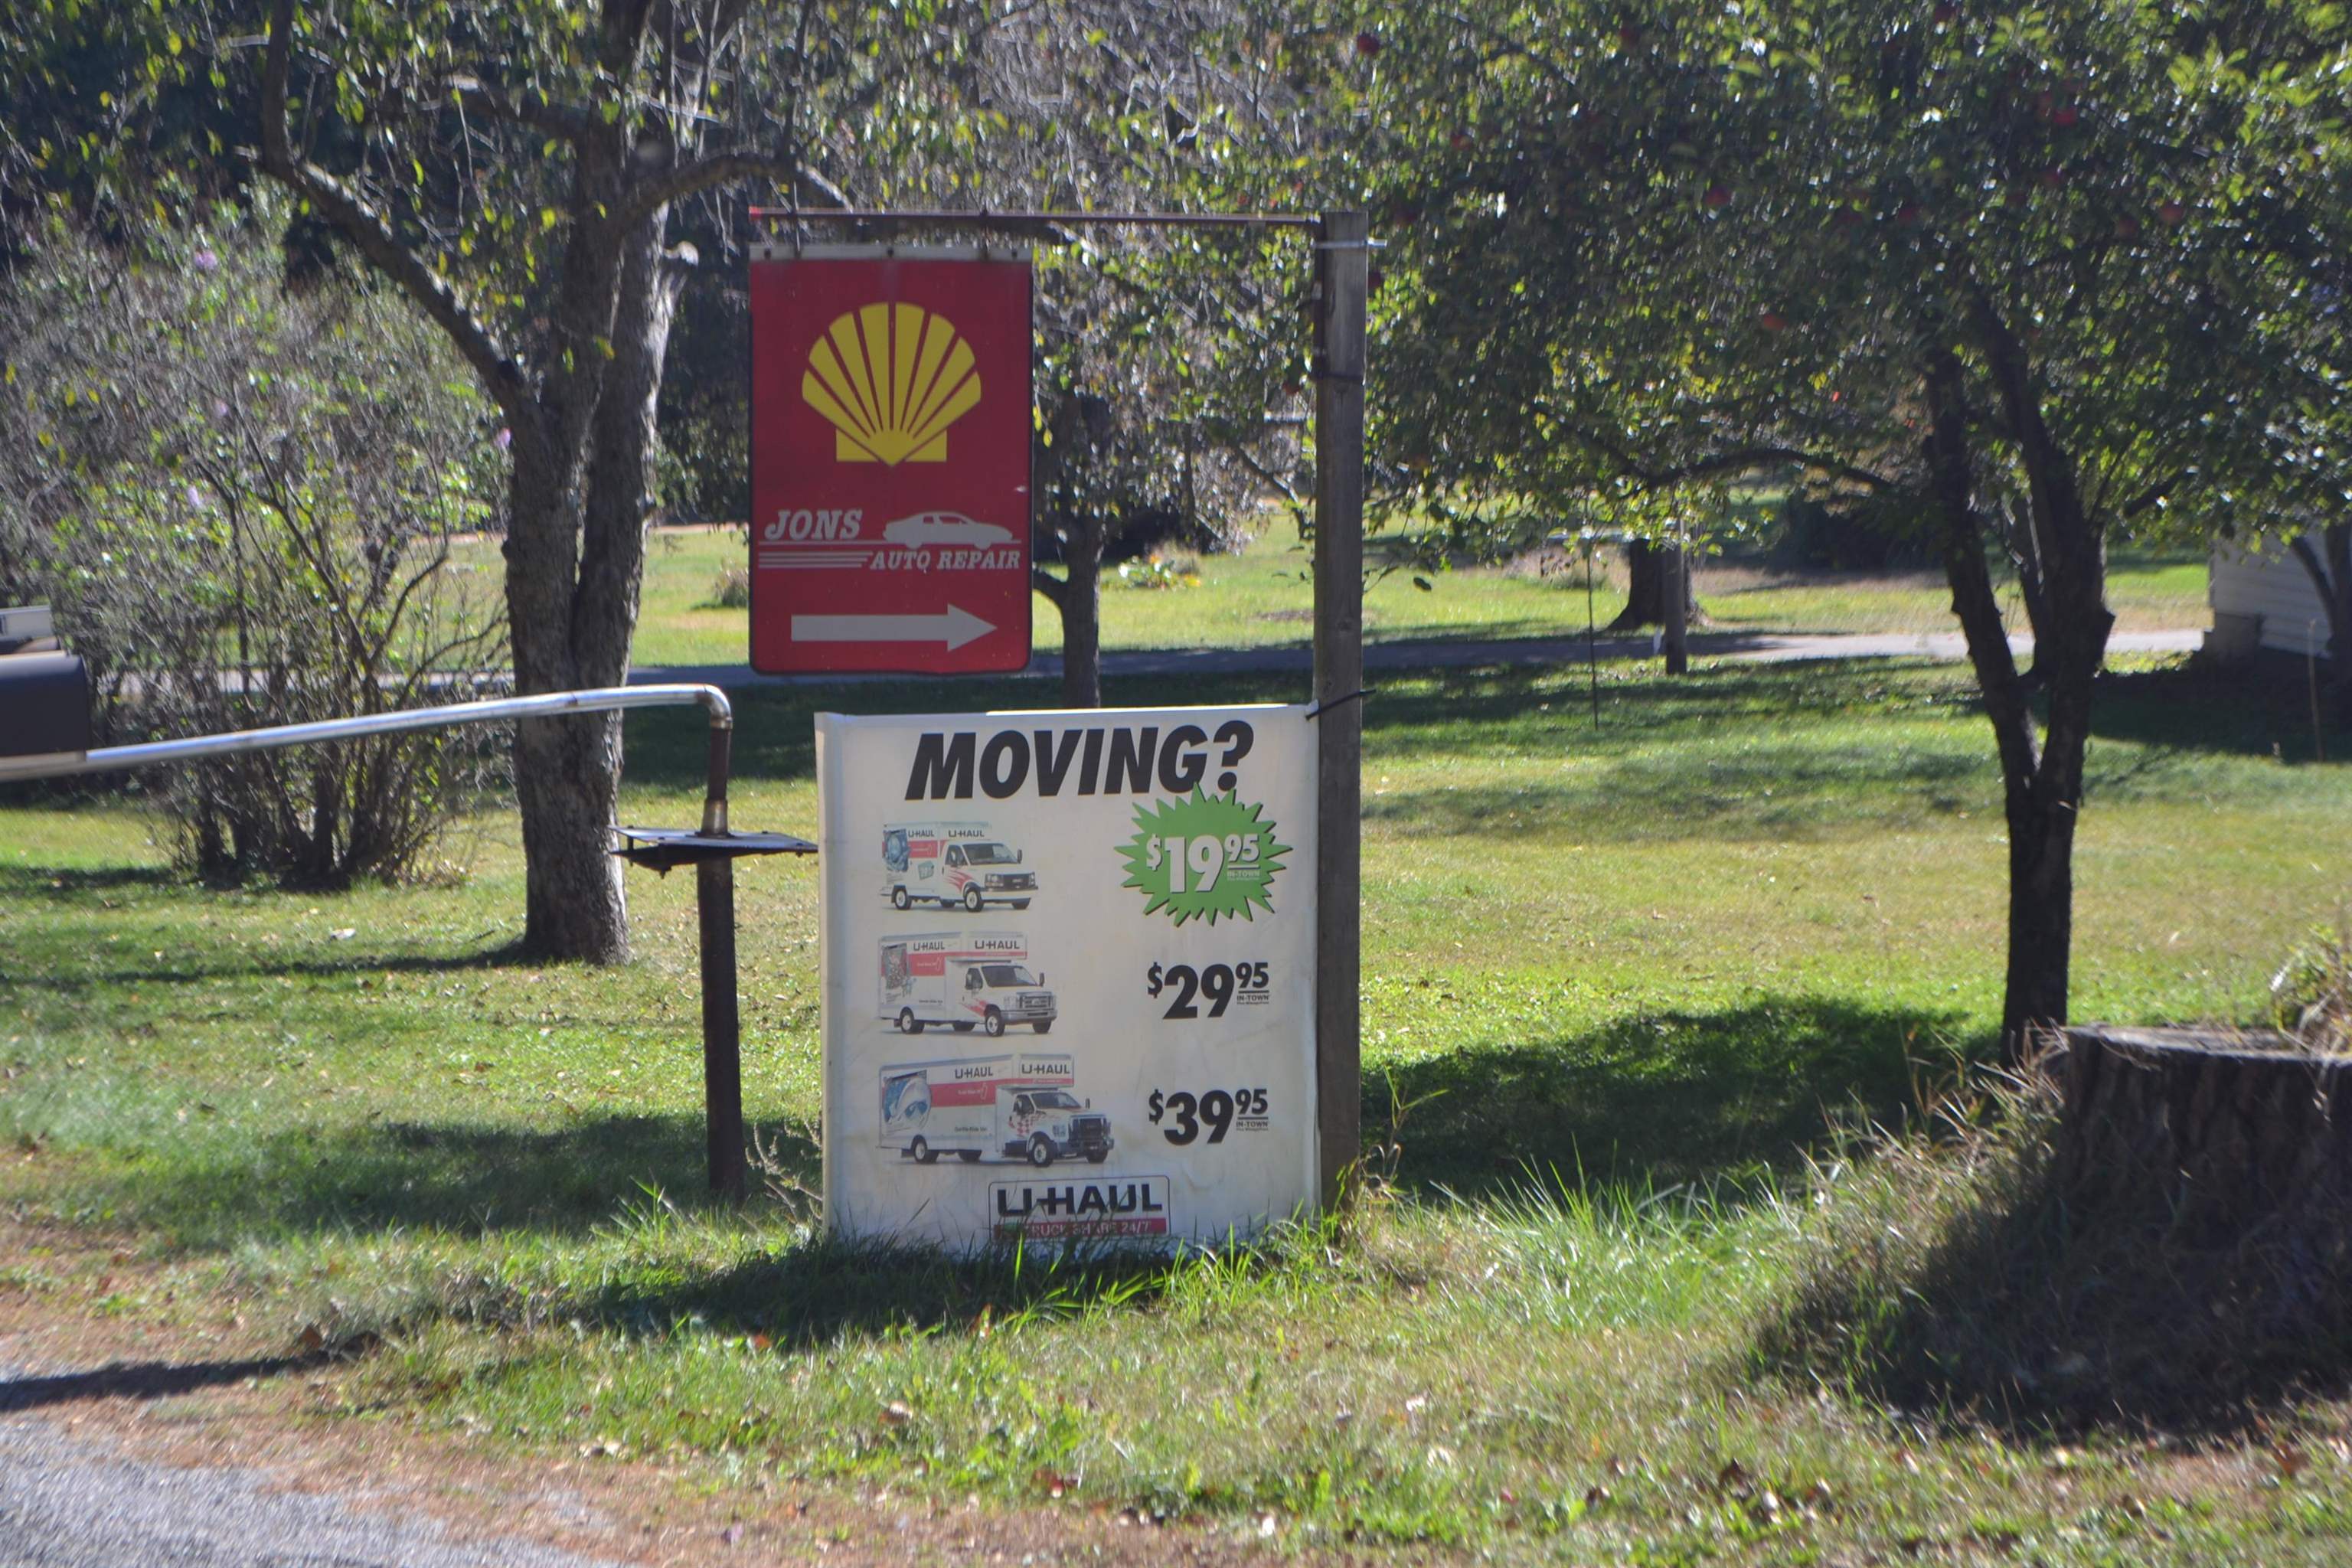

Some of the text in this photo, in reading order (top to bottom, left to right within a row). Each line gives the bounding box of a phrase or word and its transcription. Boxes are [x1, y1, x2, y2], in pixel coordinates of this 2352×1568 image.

[764, 509, 863, 541] JONS
[869, 550, 1021, 570] AUTO REPAIR
[904, 720, 1255, 801] MOVING?
[908, 829, 935, 838] U-HAUL
[948, 829, 985, 838] U-HAUL
[913, 941, 946, 952] U-HAUL
[974, 939, 1021, 950] U-HAUL
[954, 1066, 994, 1080] U-HAUL
[1021, 1063, 1070, 1075] U-HAUL
[997, 1184, 1163, 1217] U-HAUL
